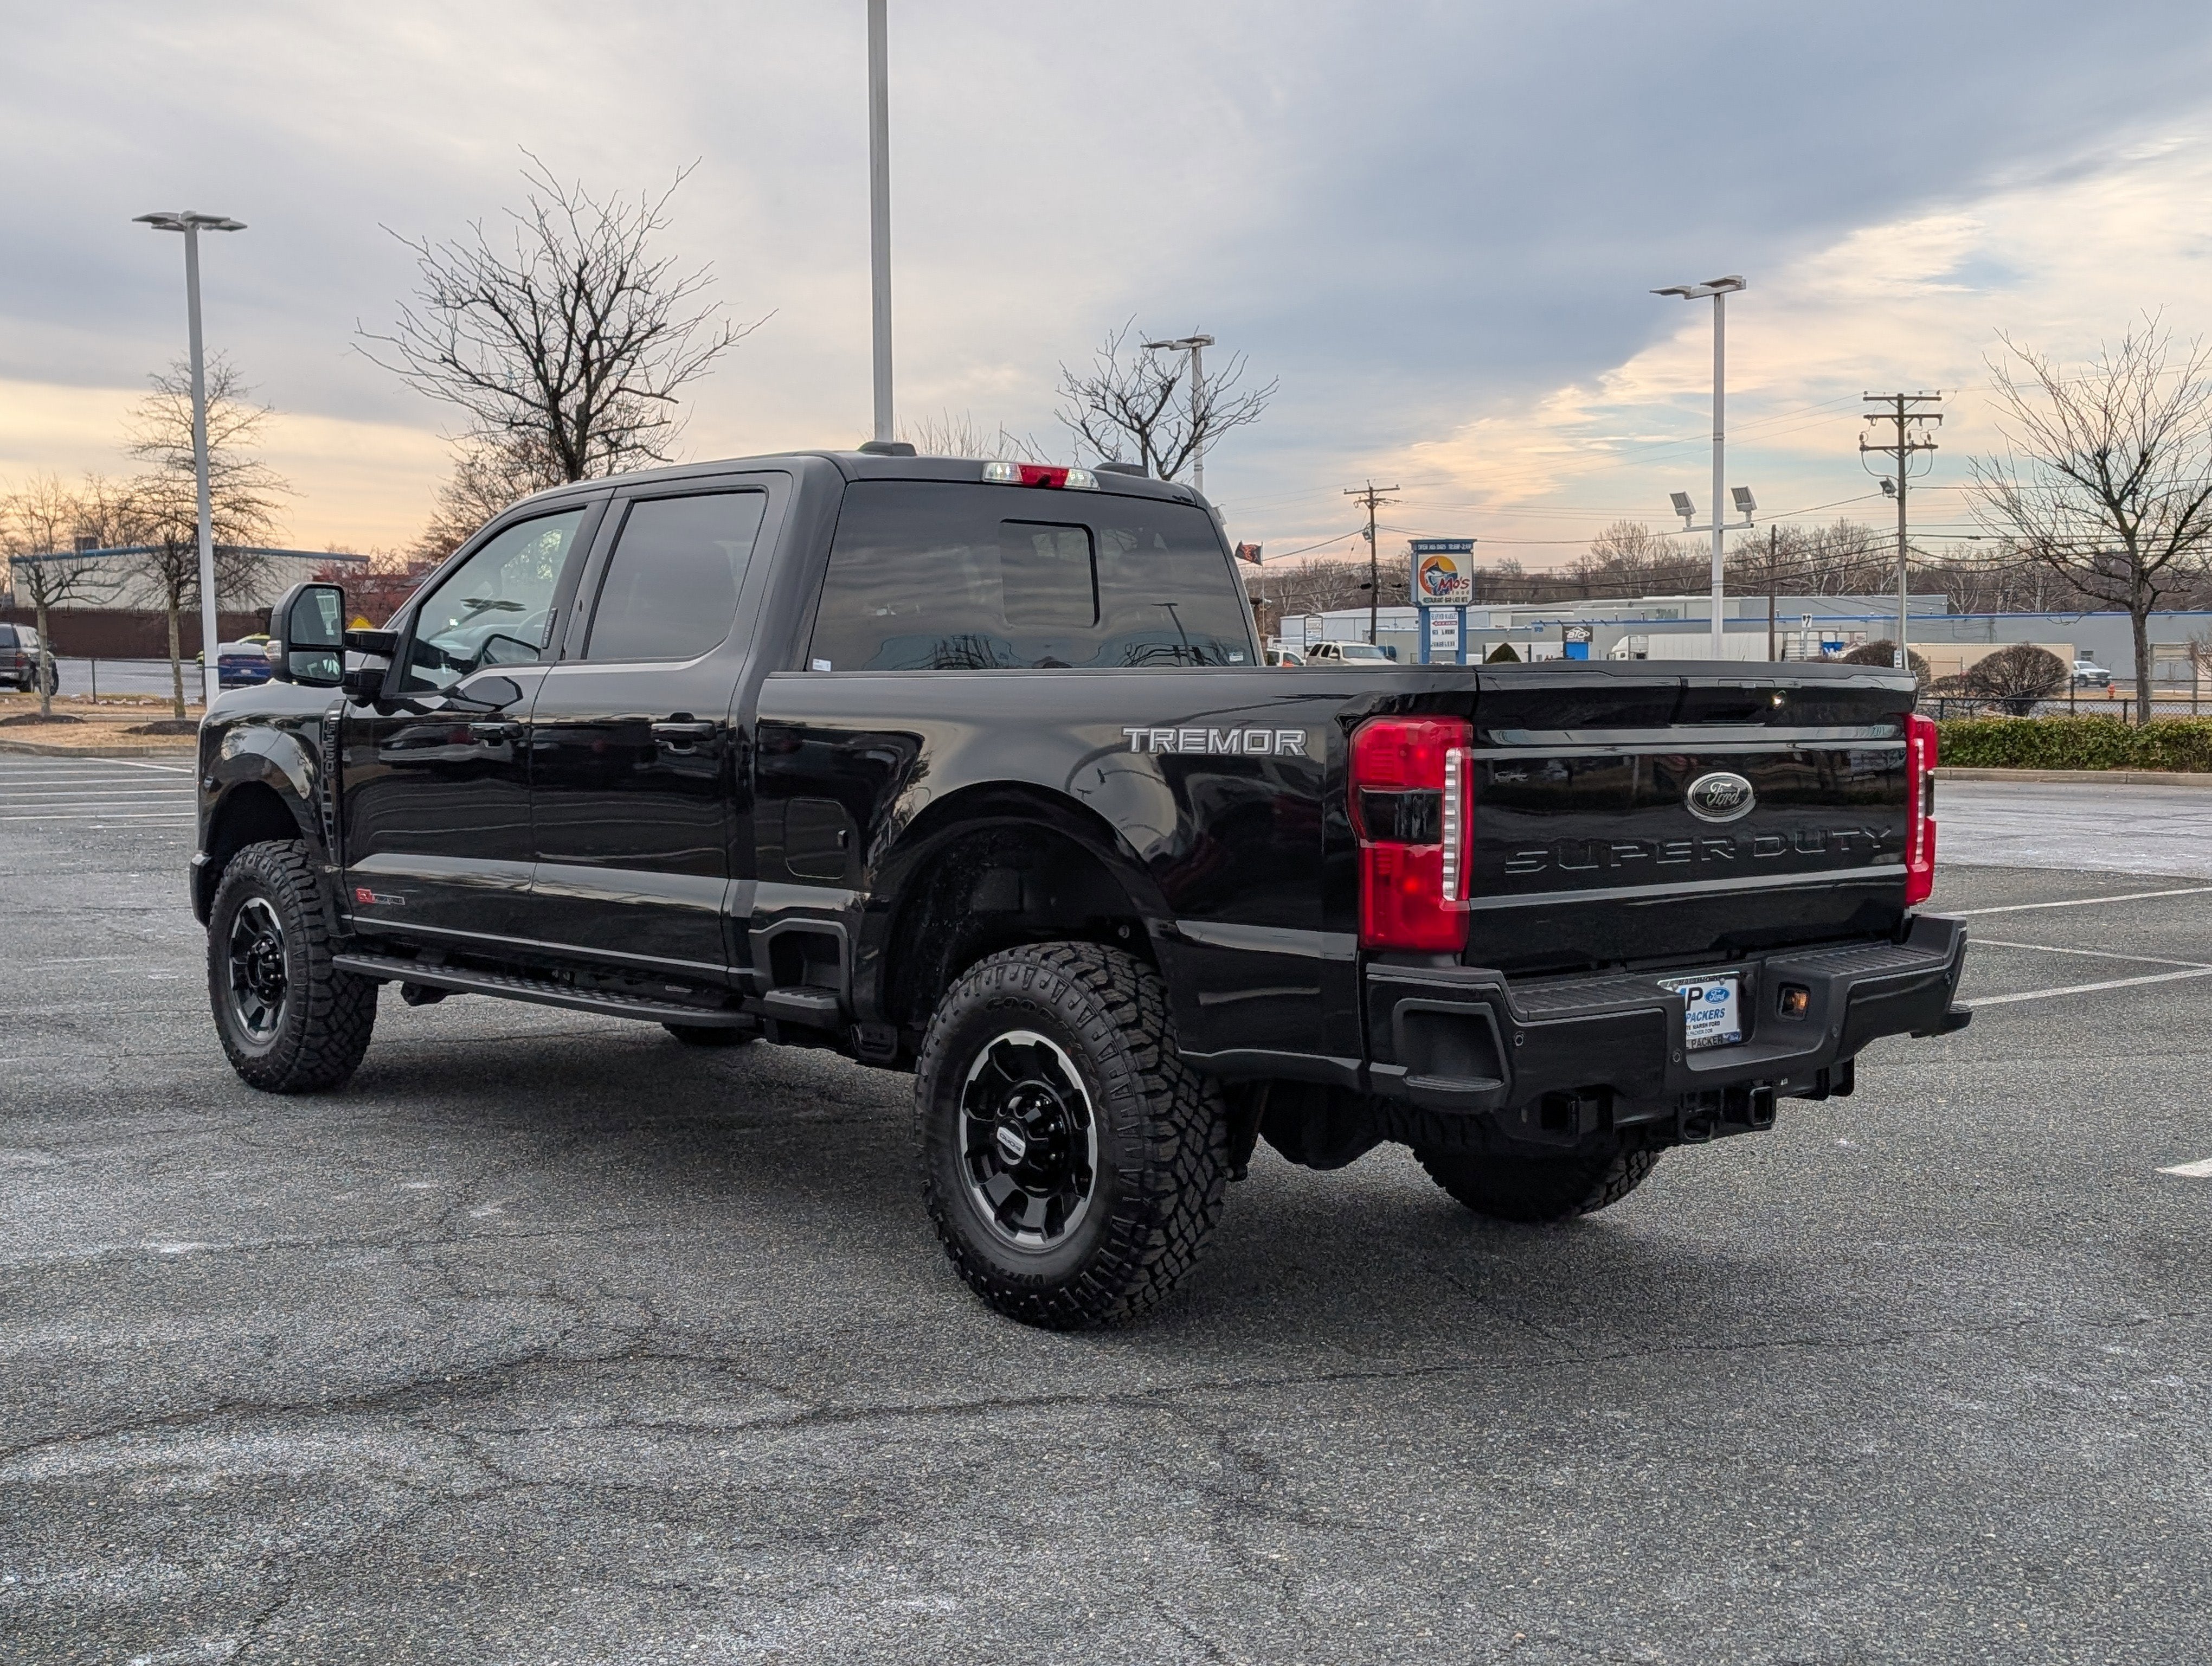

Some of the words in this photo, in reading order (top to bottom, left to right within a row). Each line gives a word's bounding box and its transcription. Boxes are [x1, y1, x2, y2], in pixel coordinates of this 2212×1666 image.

[1121, 727, 1308, 756] TREMOR
[1706, 781, 1741, 807] Ford
[1504, 839, 1736, 874] SUPER
[1753, 828, 1893, 857] DUTY
[1709, 989, 1726, 1001] Ford
[1686, 1008, 1726, 1023] PACKERS
[1691, 1034, 1723, 1048] PACKER
